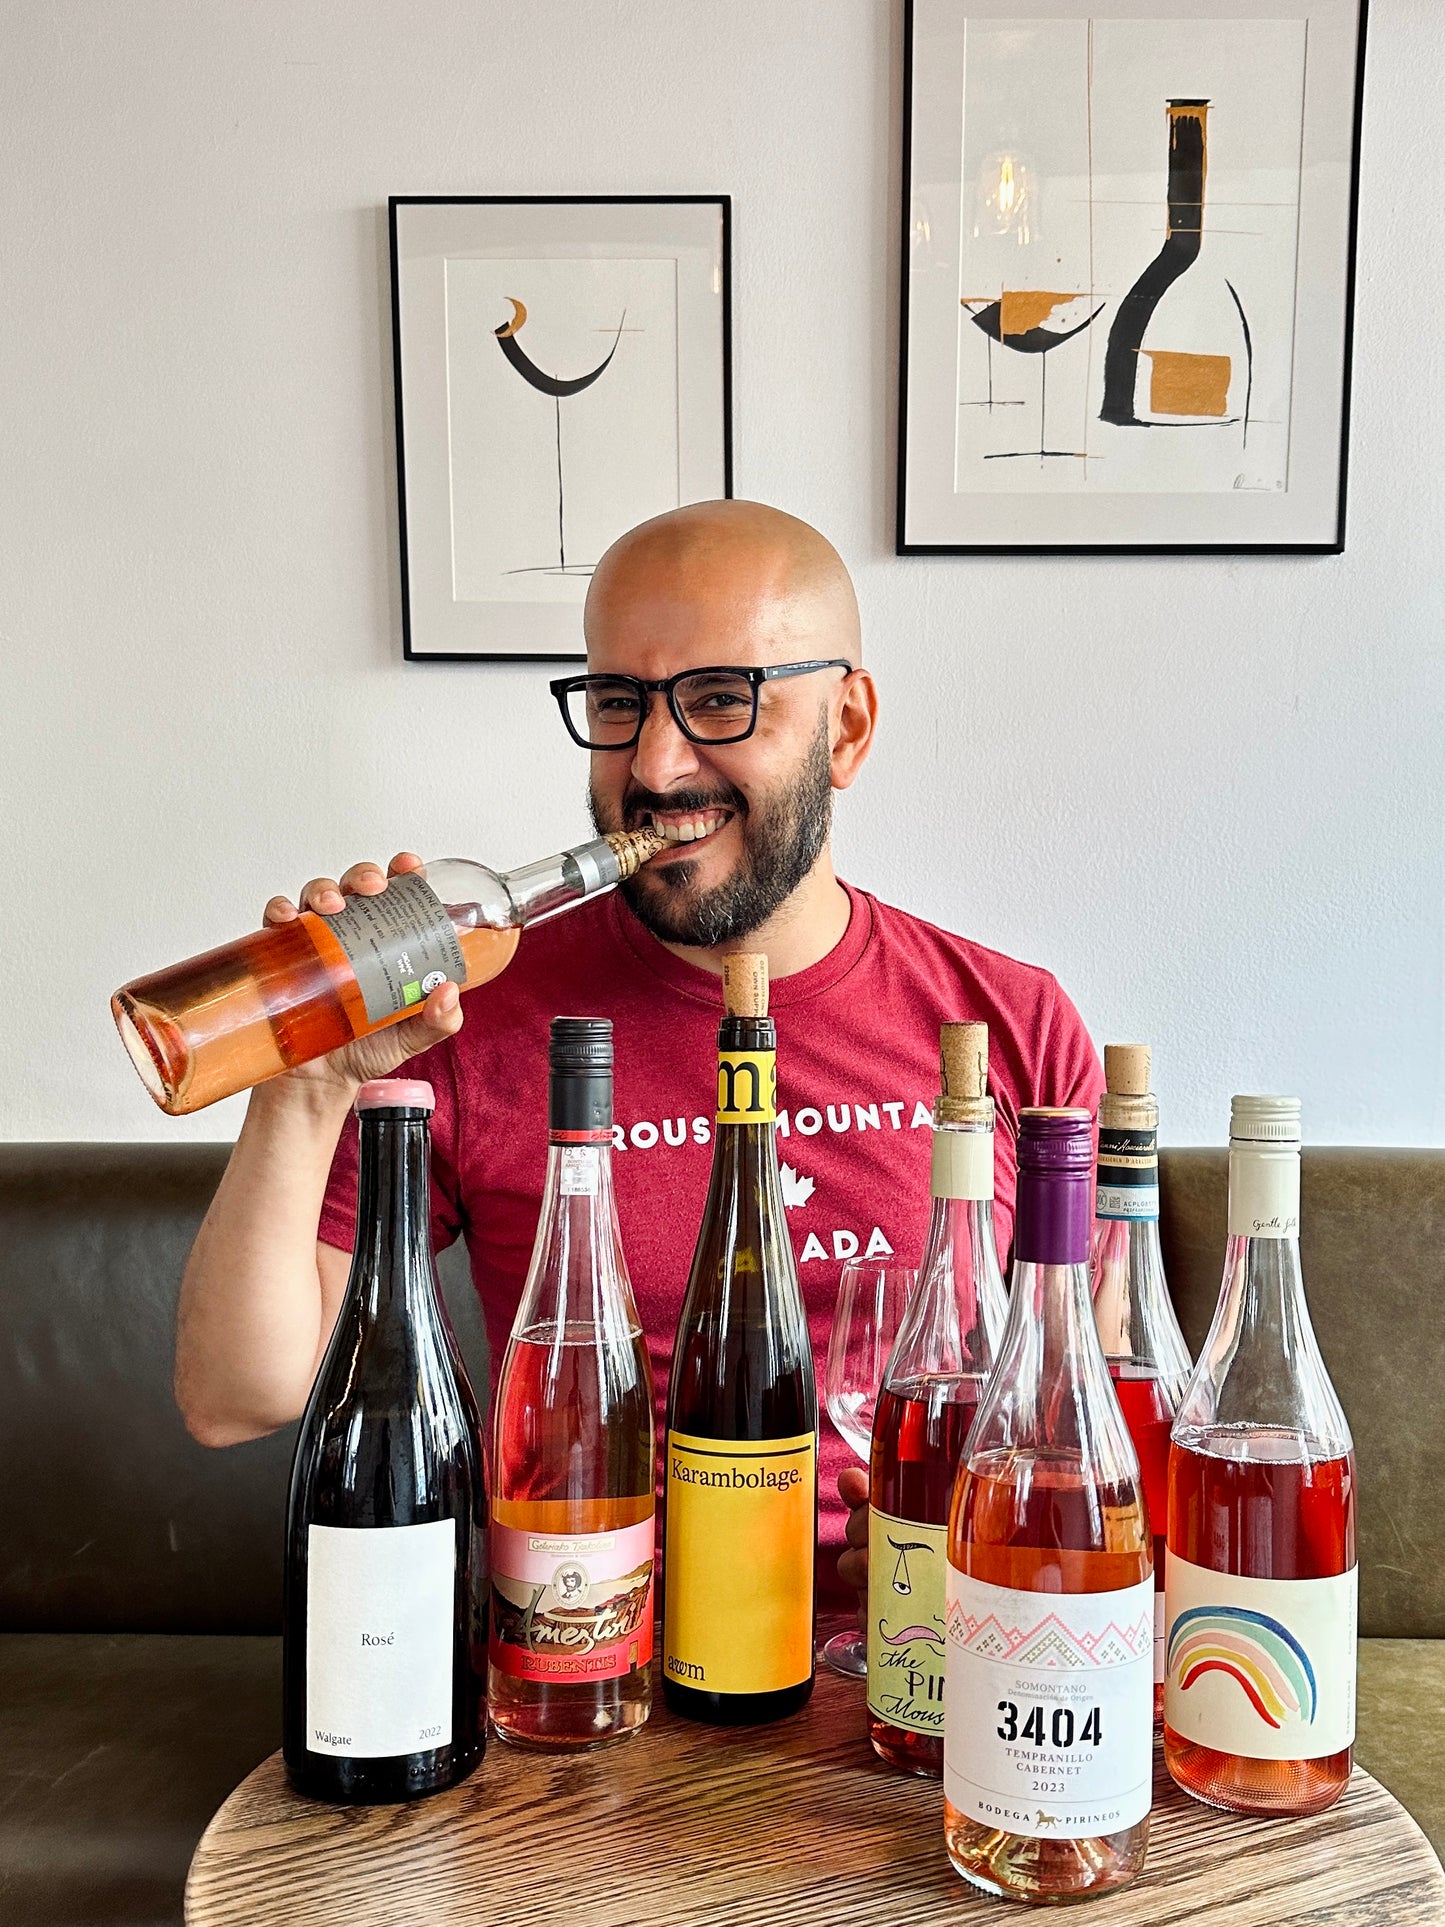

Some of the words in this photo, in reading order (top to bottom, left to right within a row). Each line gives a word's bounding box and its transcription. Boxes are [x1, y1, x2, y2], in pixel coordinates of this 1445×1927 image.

[434, 910, 445, 921] LA
[717, 1060, 777, 1112] m
[1252, 1216, 1281, 1232] Gentle
[671, 1457, 803, 1492] Karambolage.
[360, 1631, 396, 1648] Rosé
[521, 1654, 617, 1674] RUBENTIS
[878, 1647, 926, 1669] the
[1015, 1679, 1087, 1694] SOMONTANO
[997, 1700, 1103, 1748] 3404
[314, 1729, 353, 1747] Walgate
[418, 1725, 442, 1741] 2022
[1005, 1747, 1094, 1763] TEMPRANILLO
[1016, 1762, 1082, 1776] CABERNET
[1031, 1780, 1066, 1793] 2023
[978, 1800, 1031, 1822] BODEGA
[1065, 1809, 1121, 1825] PIRINEOS
